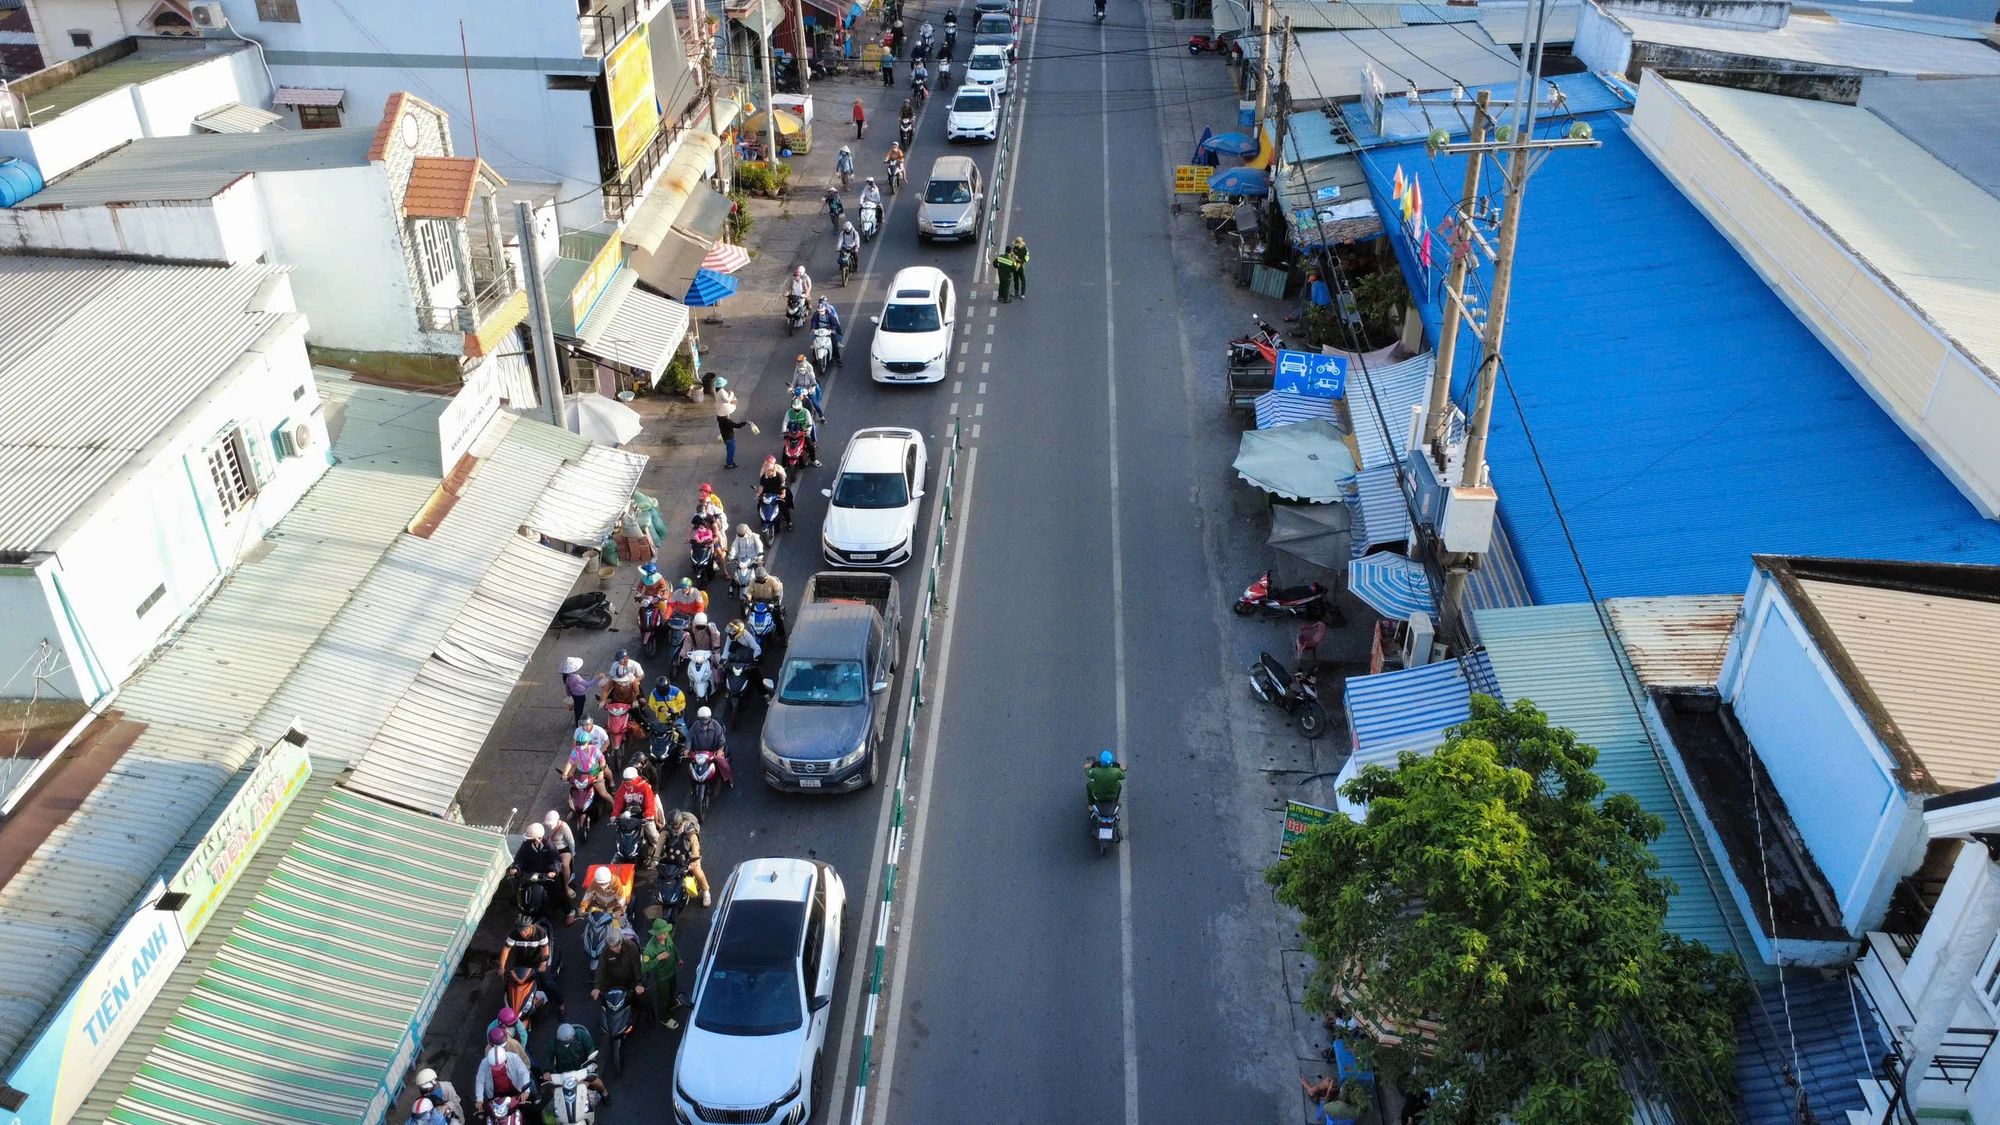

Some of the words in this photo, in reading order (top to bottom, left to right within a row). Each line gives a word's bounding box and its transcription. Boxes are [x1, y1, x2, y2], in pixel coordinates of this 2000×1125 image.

[251, 774, 288, 830] ANH
[82, 974, 132, 1047] TIẾN
[131, 921, 168, 986] ANH
